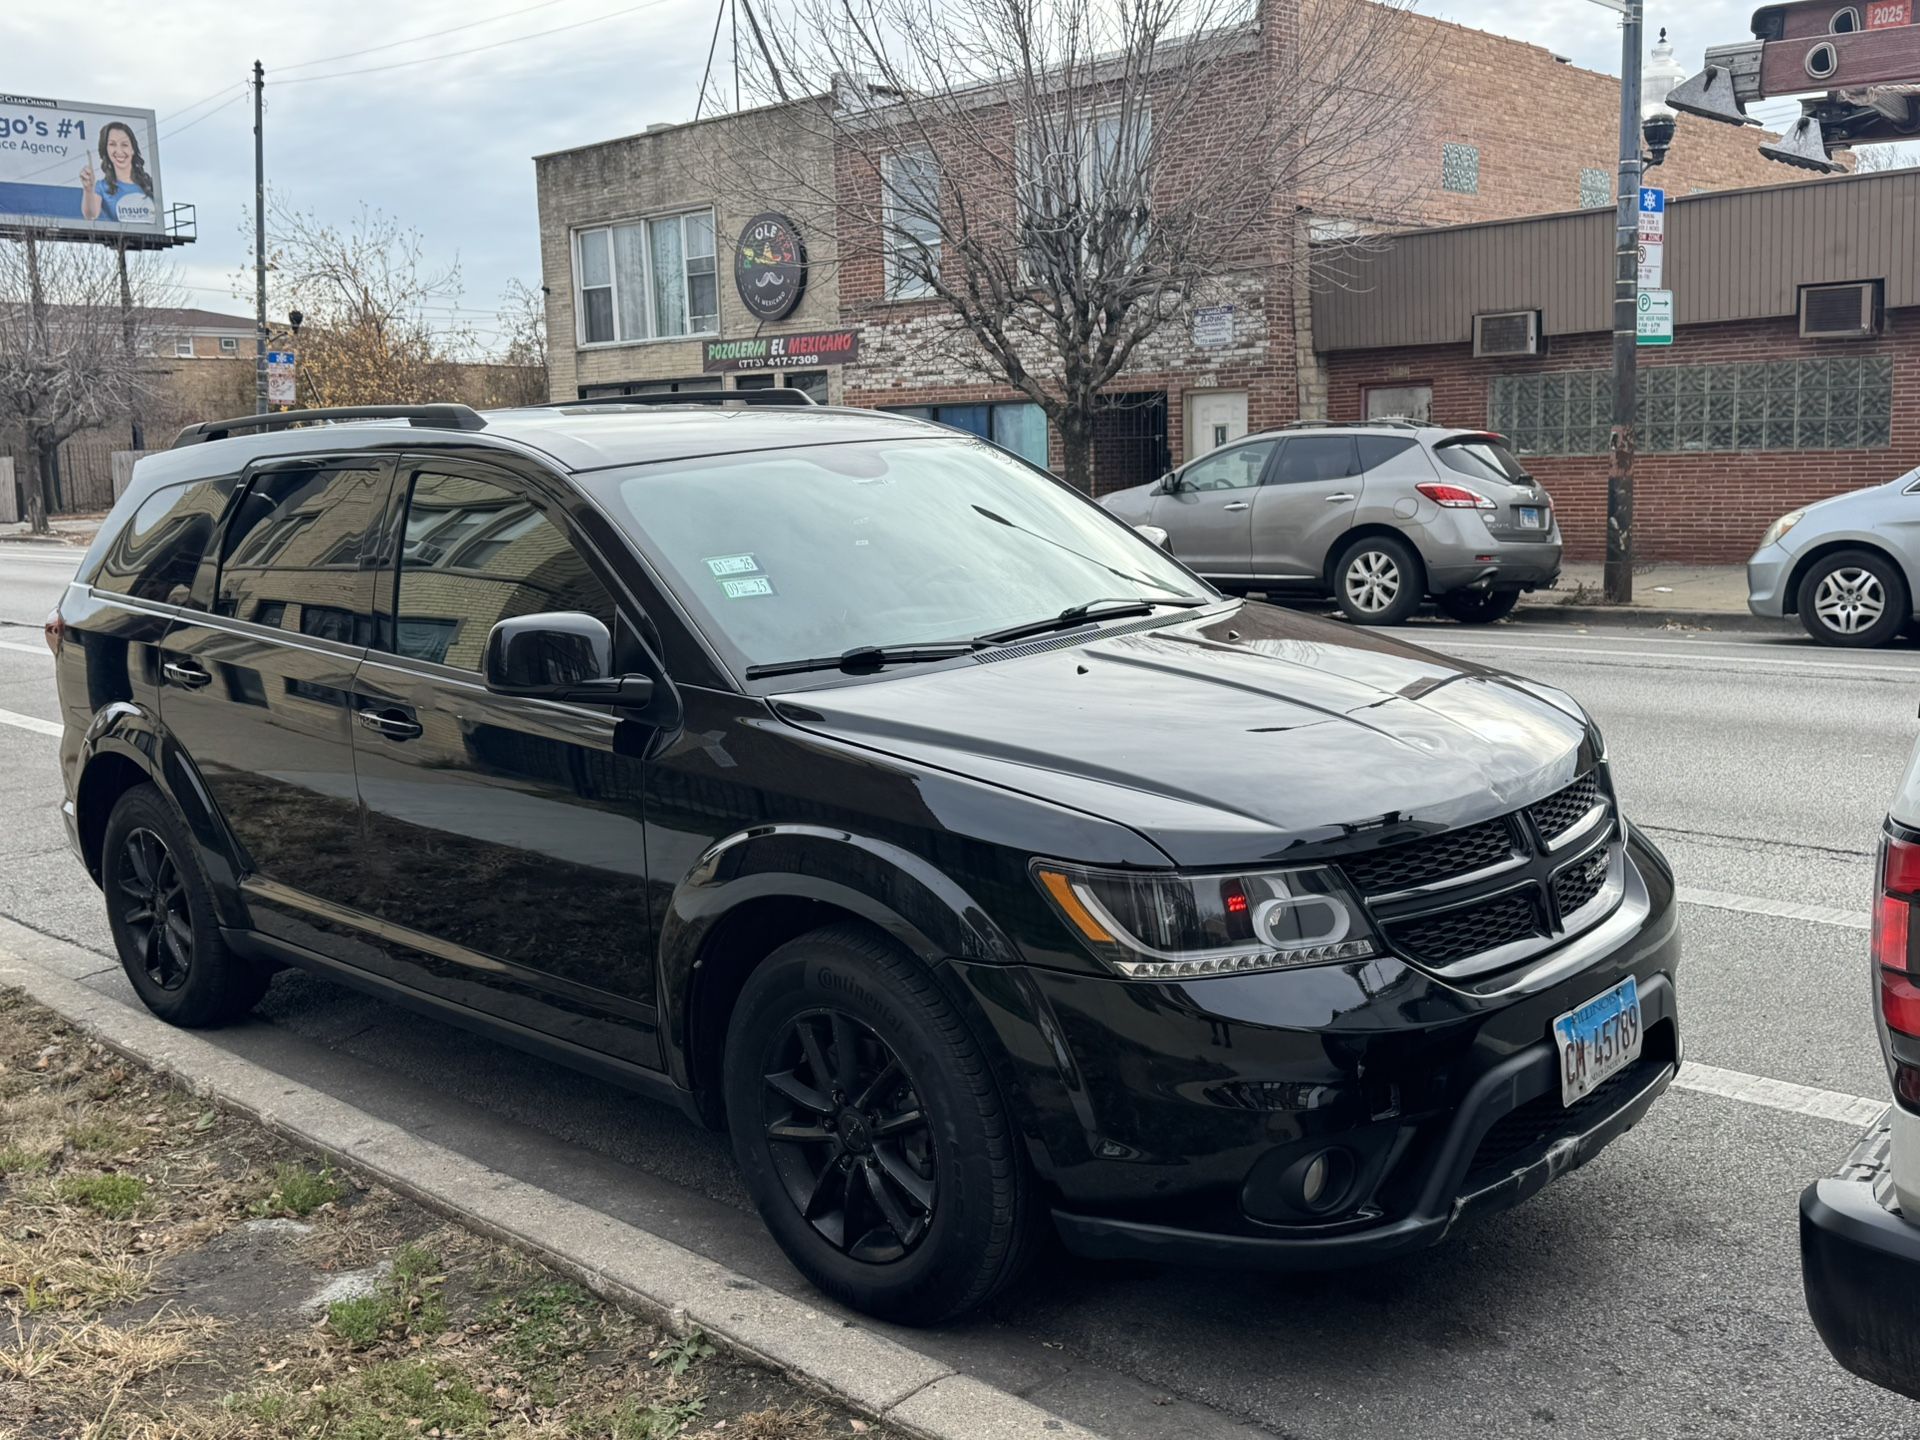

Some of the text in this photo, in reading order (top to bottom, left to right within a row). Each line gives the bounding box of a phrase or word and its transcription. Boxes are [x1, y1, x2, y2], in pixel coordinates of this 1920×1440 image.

[1873, 5, 1904, 25] 2025
[57, 118, 86, 140] #1
[21, 140, 68, 157] Agency
[708, 333, 853, 360] POZOLERIA EL MEXICANO
[738, 355, 819, 369] (773) 417-7309
[1594, 1004, 1638, 1067] 45789
